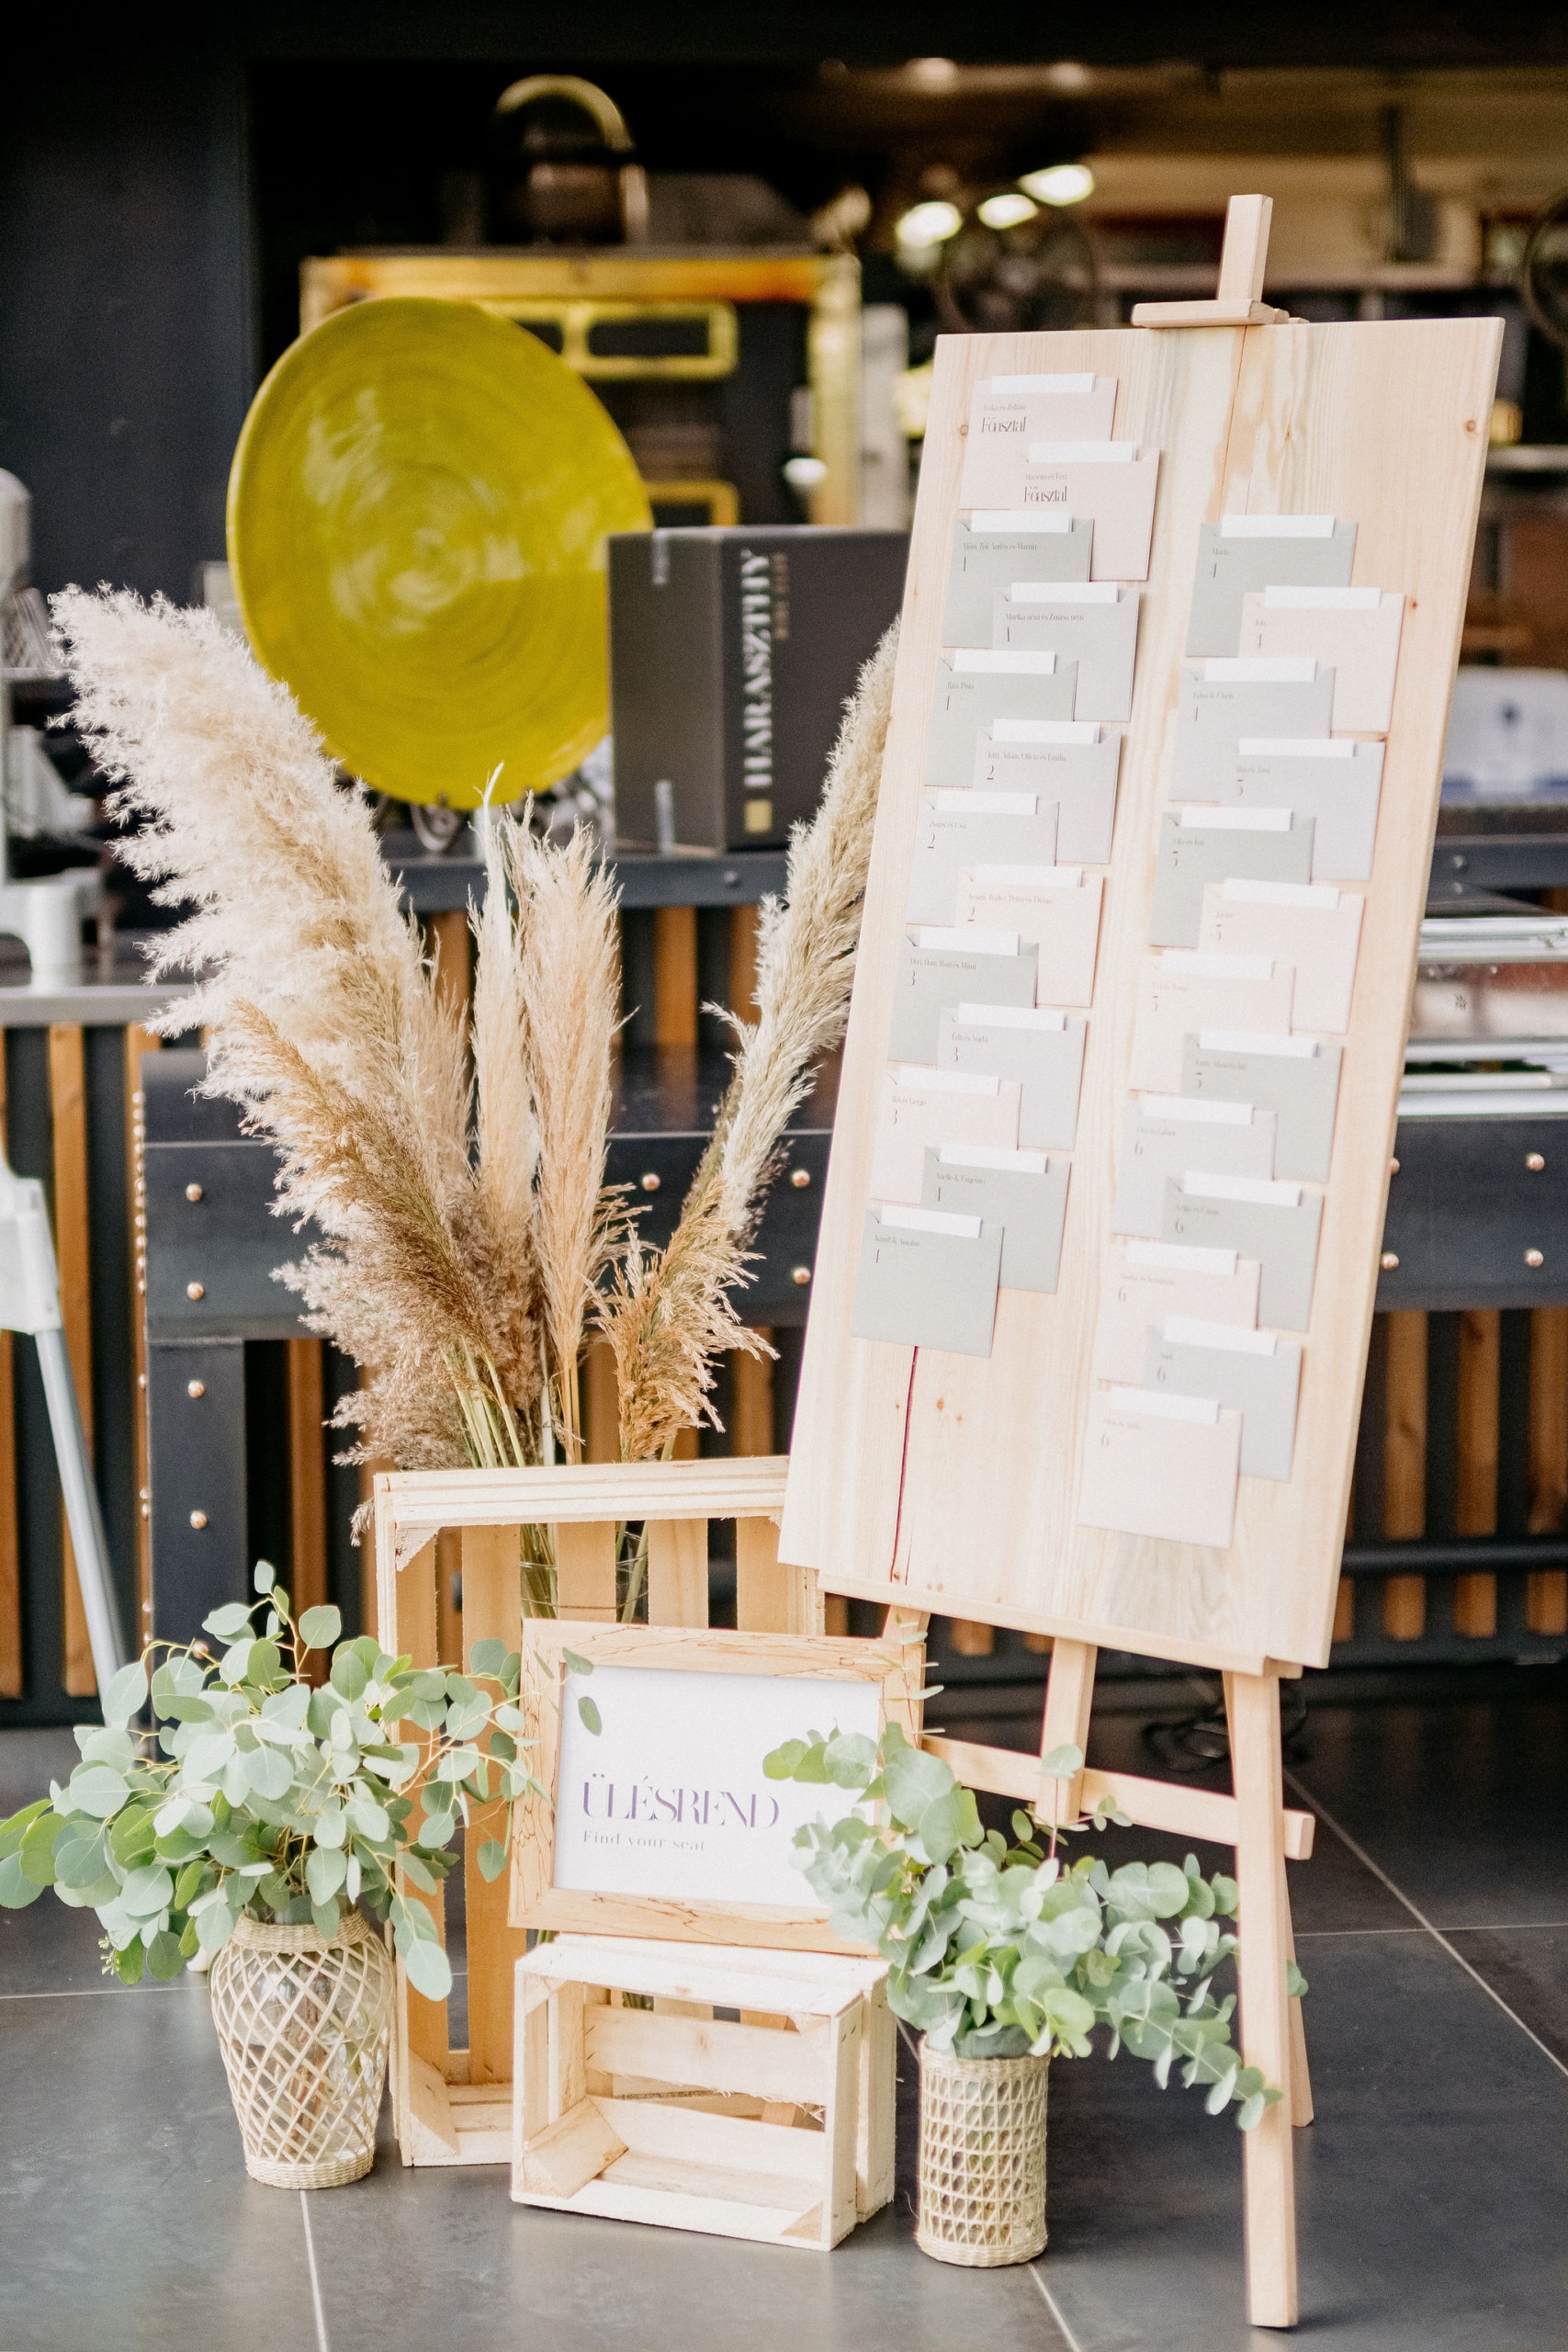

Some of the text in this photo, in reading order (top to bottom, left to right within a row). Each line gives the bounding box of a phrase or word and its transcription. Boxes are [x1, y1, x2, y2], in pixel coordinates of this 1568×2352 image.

[740, 548, 773, 789] HARASZTHY
[986, 763, 995, 781] 2
[927, 832, 935, 849] 2
[967, 905, 976, 922] 2
[910, 969, 917, 987] 3
[953, 1046, 959, 1063] 3
[893, 1108, 899, 1125] 3
[1134, 1140, 1144, 1157] 6
[1175, 1217, 1184, 1235] 6
[1118, 1286, 1127, 1303] 6
[1156, 1365, 1167, 1383] 6
[1100, 1430, 1110, 1448] 6
[582, 1772, 780, 1829] ÜLÉSREND
[583, 1829, 705, 1852] Find your seat
